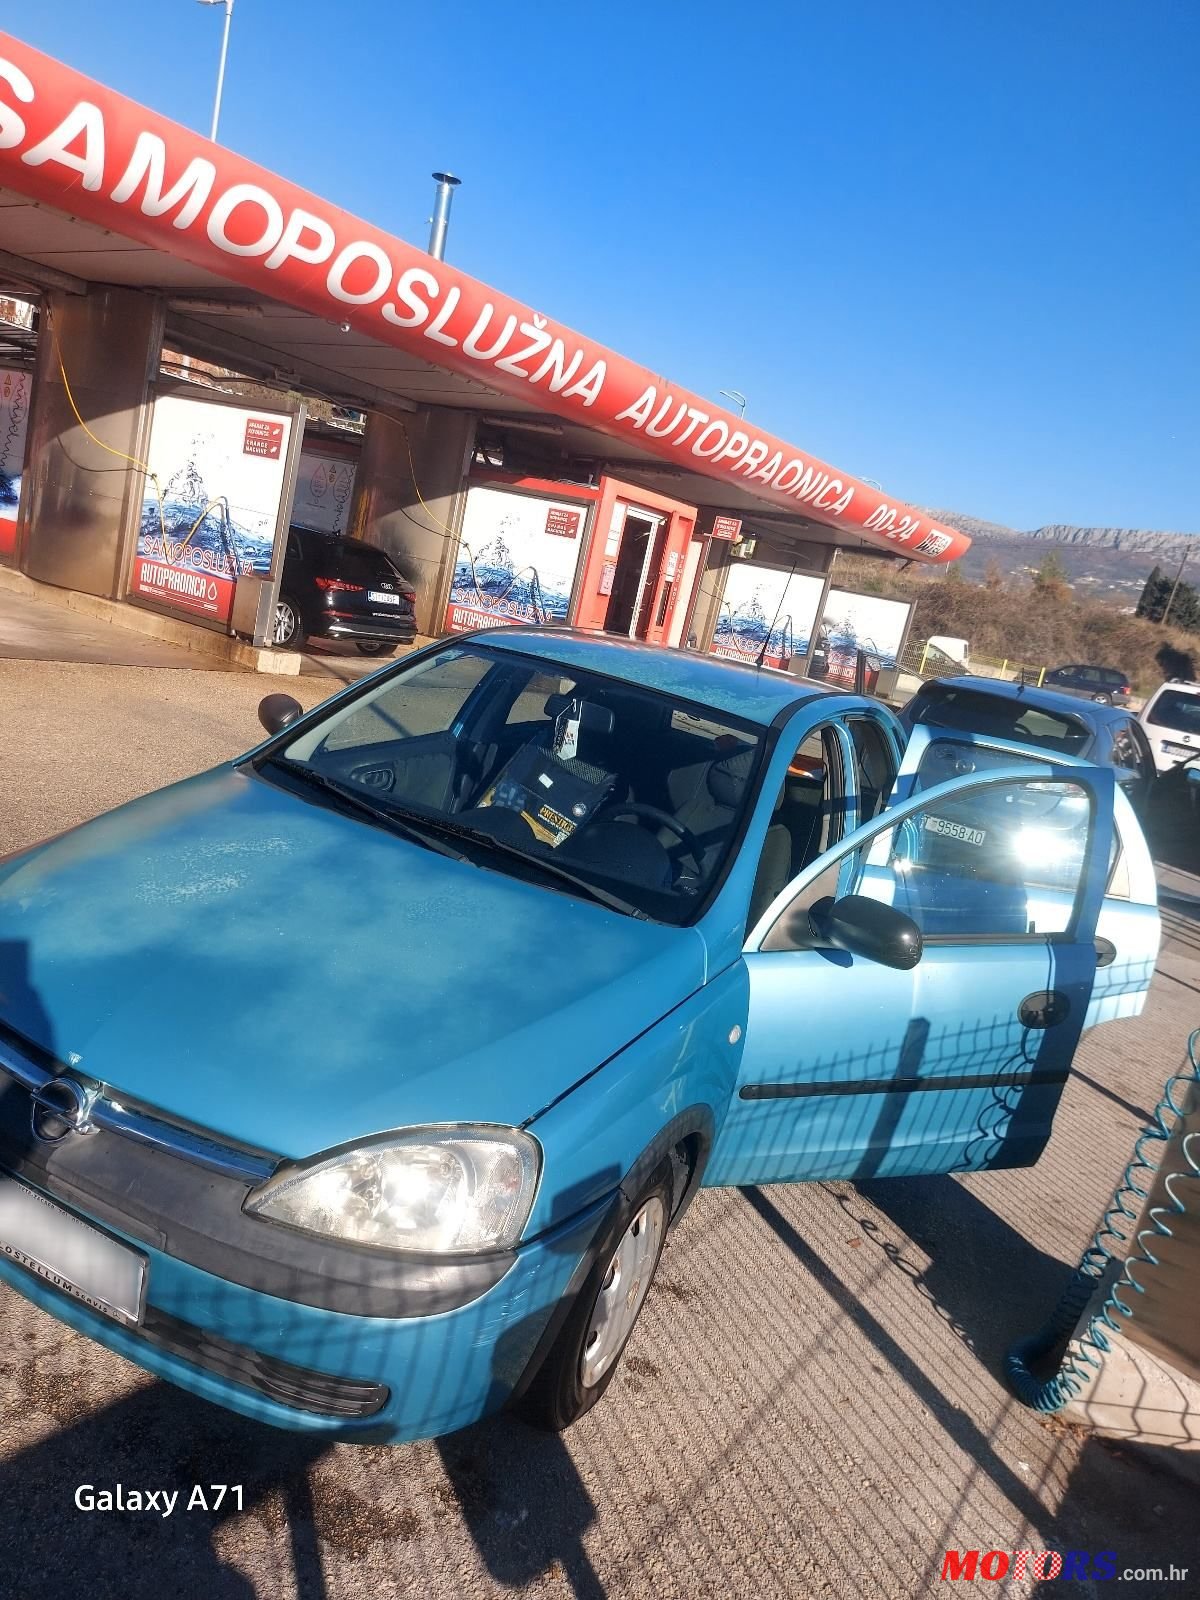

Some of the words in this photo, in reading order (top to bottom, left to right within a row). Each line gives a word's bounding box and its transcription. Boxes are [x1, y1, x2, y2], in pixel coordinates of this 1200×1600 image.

[0, 57, 608, 407] SAMOPOSLUŽNA
[614, 385, 855, 516] AUTOPRAONICA
[140, 562, 207, 599] AUTOPRAONICA
[0, 1245, 73, 1292] OSTELLUM
